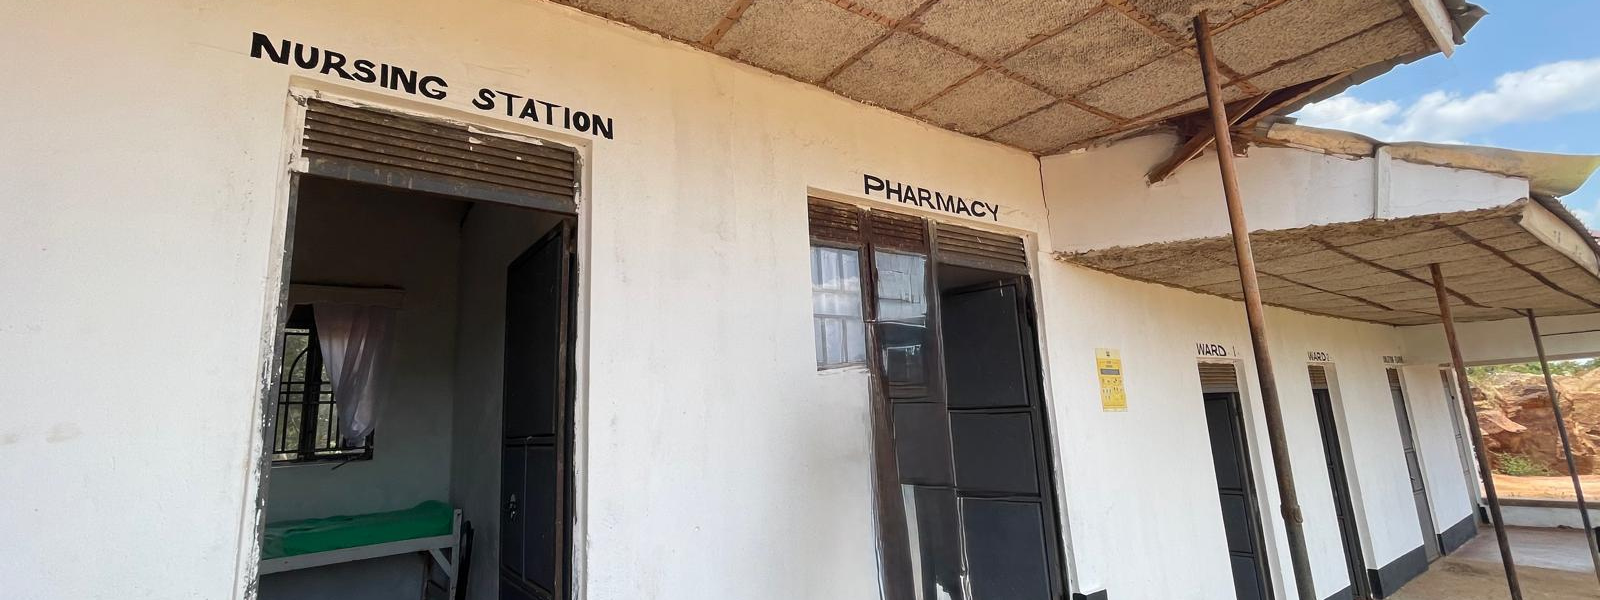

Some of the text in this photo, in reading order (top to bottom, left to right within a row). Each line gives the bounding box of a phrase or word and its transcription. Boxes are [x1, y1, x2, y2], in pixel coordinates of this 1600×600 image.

[250, 32, 614, 140] NURSING STATION
[863, 173, 999, 222] PHARMACY
[1196, 343, 1227, 357] WARD
[1307, 351, 1326, 362] WARD
